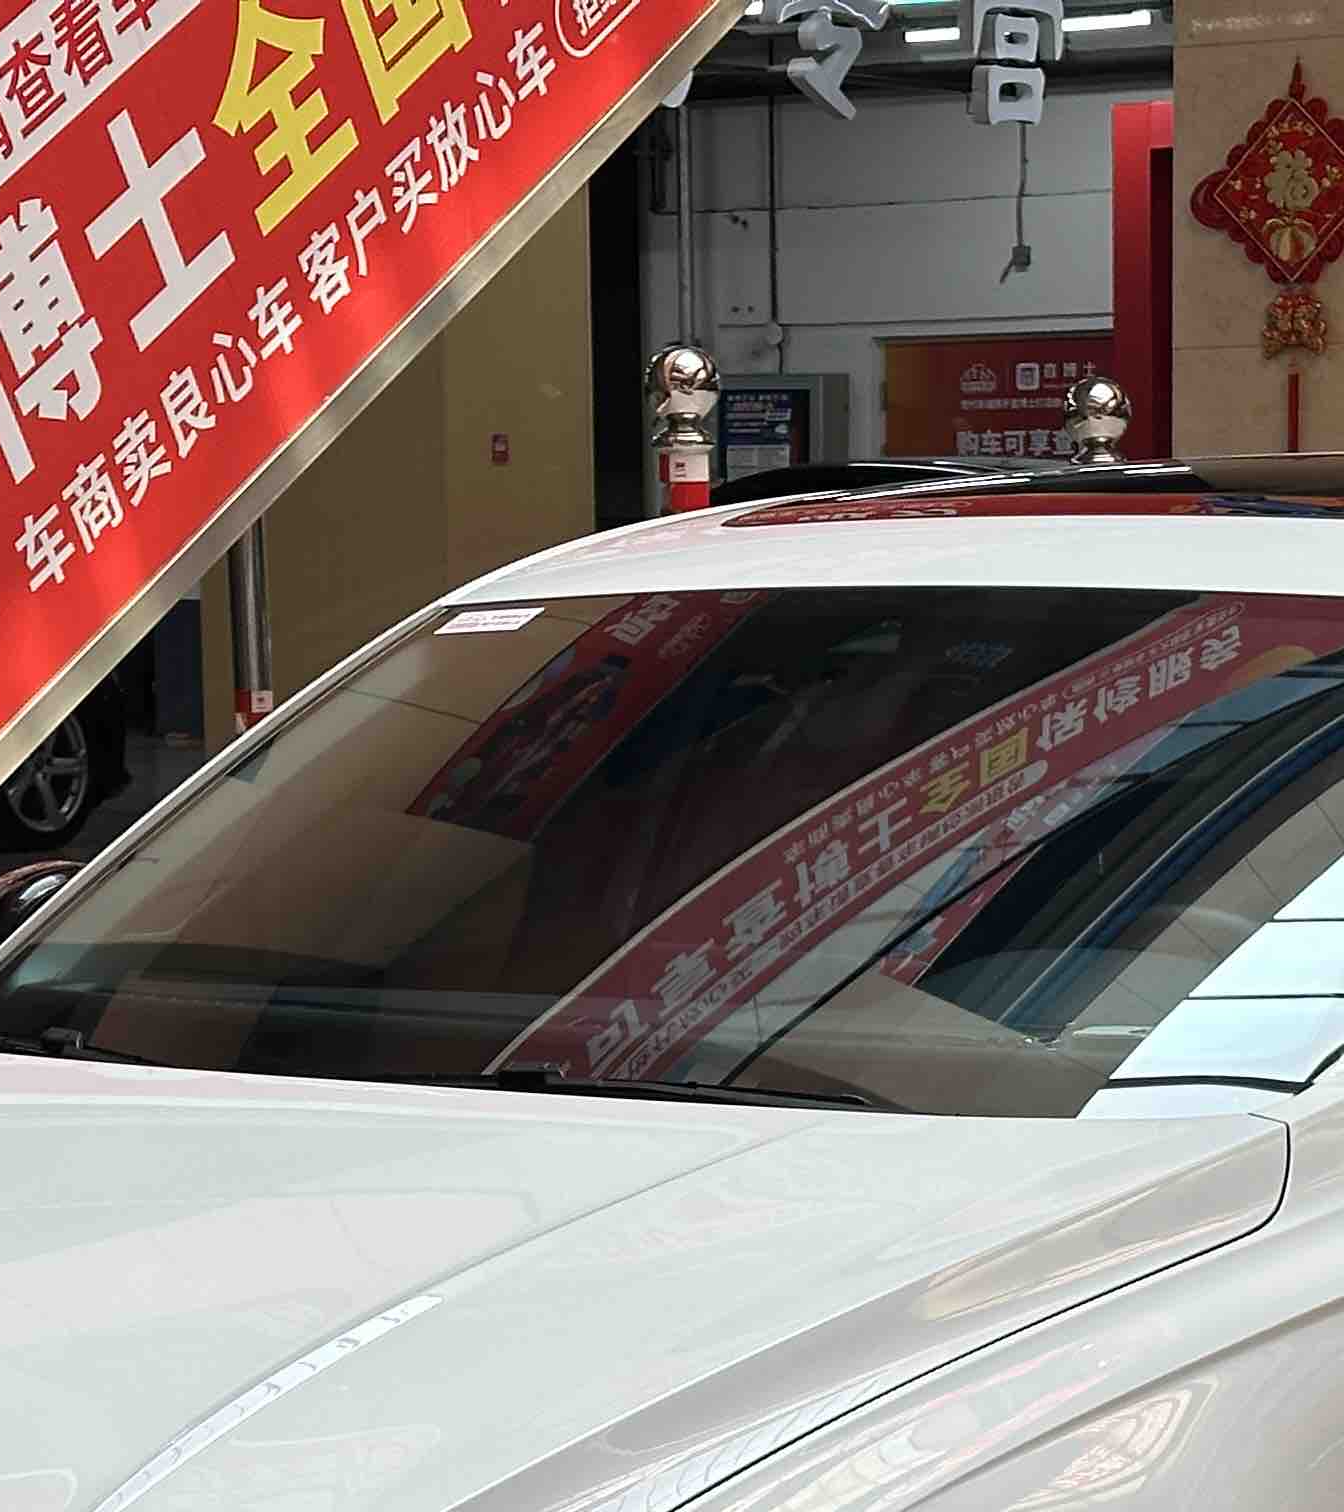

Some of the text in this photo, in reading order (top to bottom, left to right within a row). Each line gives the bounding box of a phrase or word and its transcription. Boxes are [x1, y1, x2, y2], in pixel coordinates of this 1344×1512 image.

[15, 22, 559, 594] 车商卖良心车 客户买放心车
